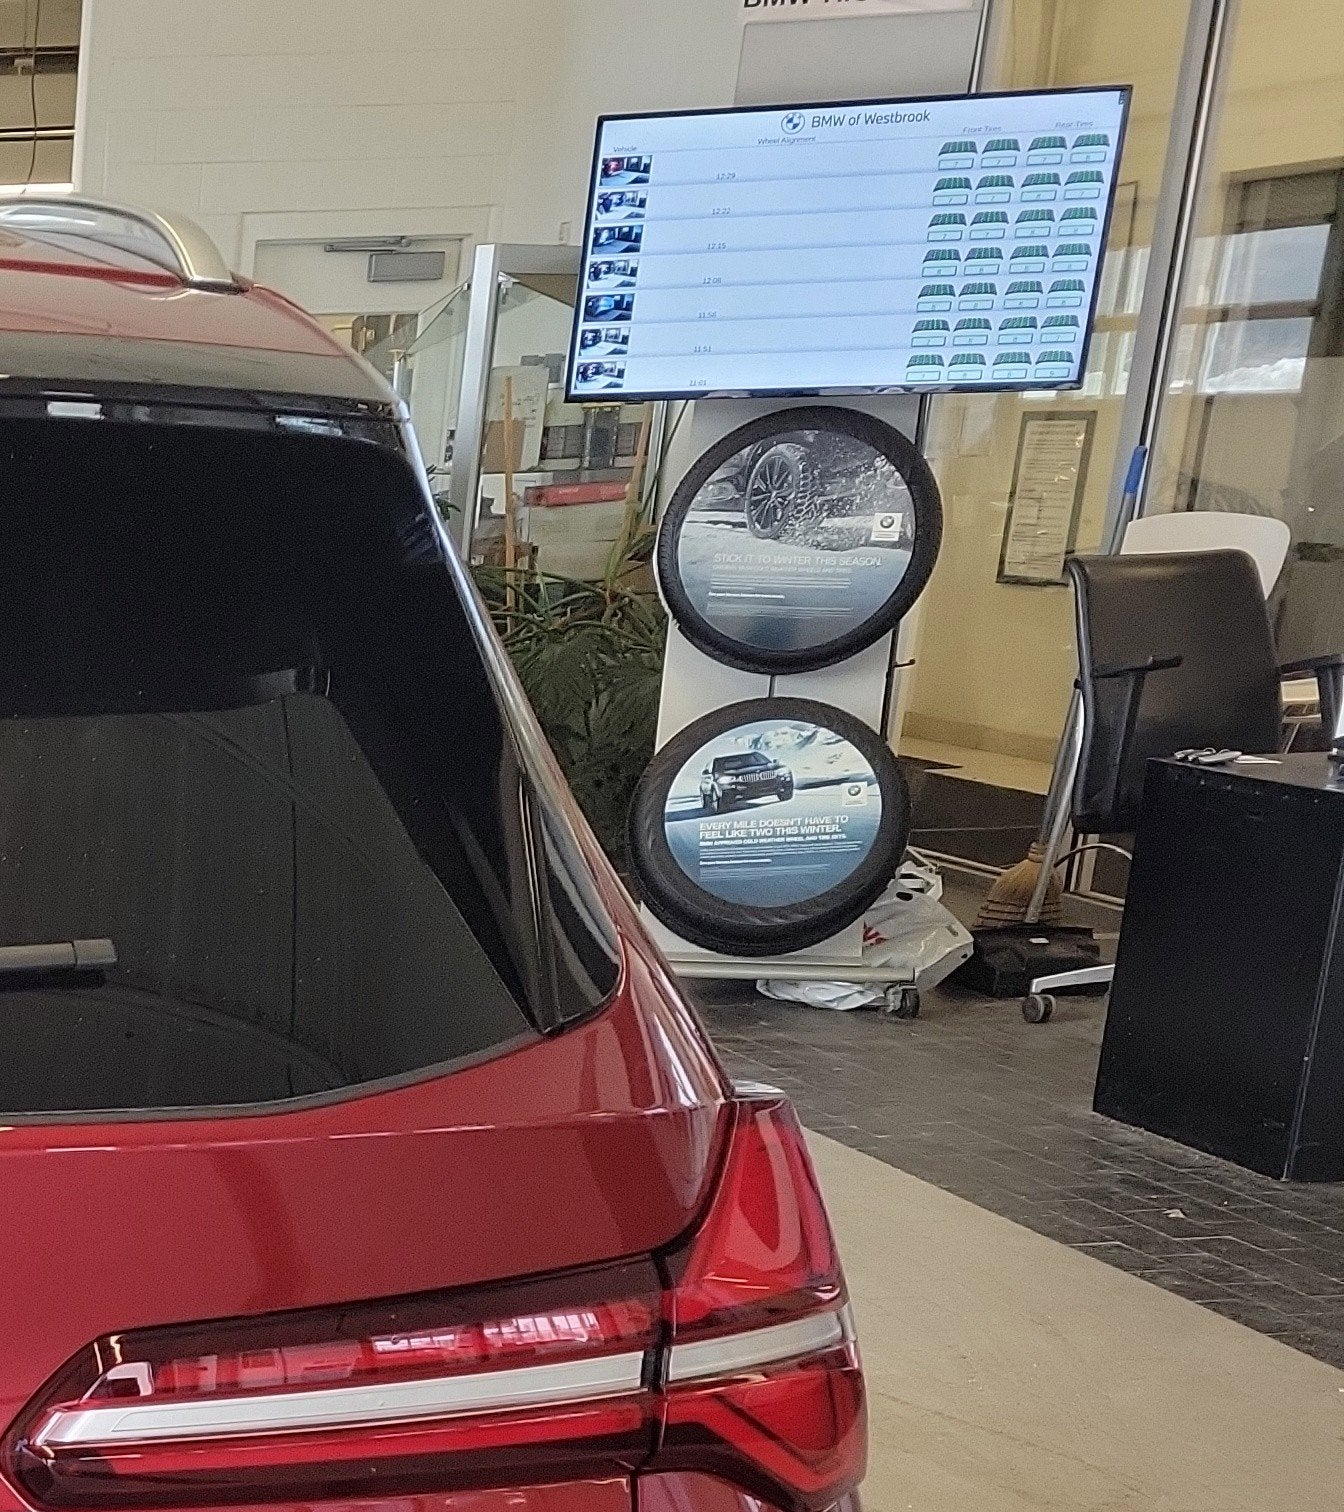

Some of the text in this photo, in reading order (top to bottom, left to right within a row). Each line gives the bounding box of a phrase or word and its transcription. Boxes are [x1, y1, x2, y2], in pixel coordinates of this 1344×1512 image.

[812, 109, 930, 128] BMW of Westbrook
[781, 136, 815, 145] Alignment
[714, 553, 742, 563] STICK
[743, 554, 753, 563] IT
[758, 554, 771, 564] TO
[773, 555, 811, 565] WINTER
[814, 556, 837, 566] THIS
[700, 815, 848, 831] EVERY MILE DOESN'T HAVE TO
[700, 825, 842, 839] FEEL LIKE TWO THIS WINTER.
